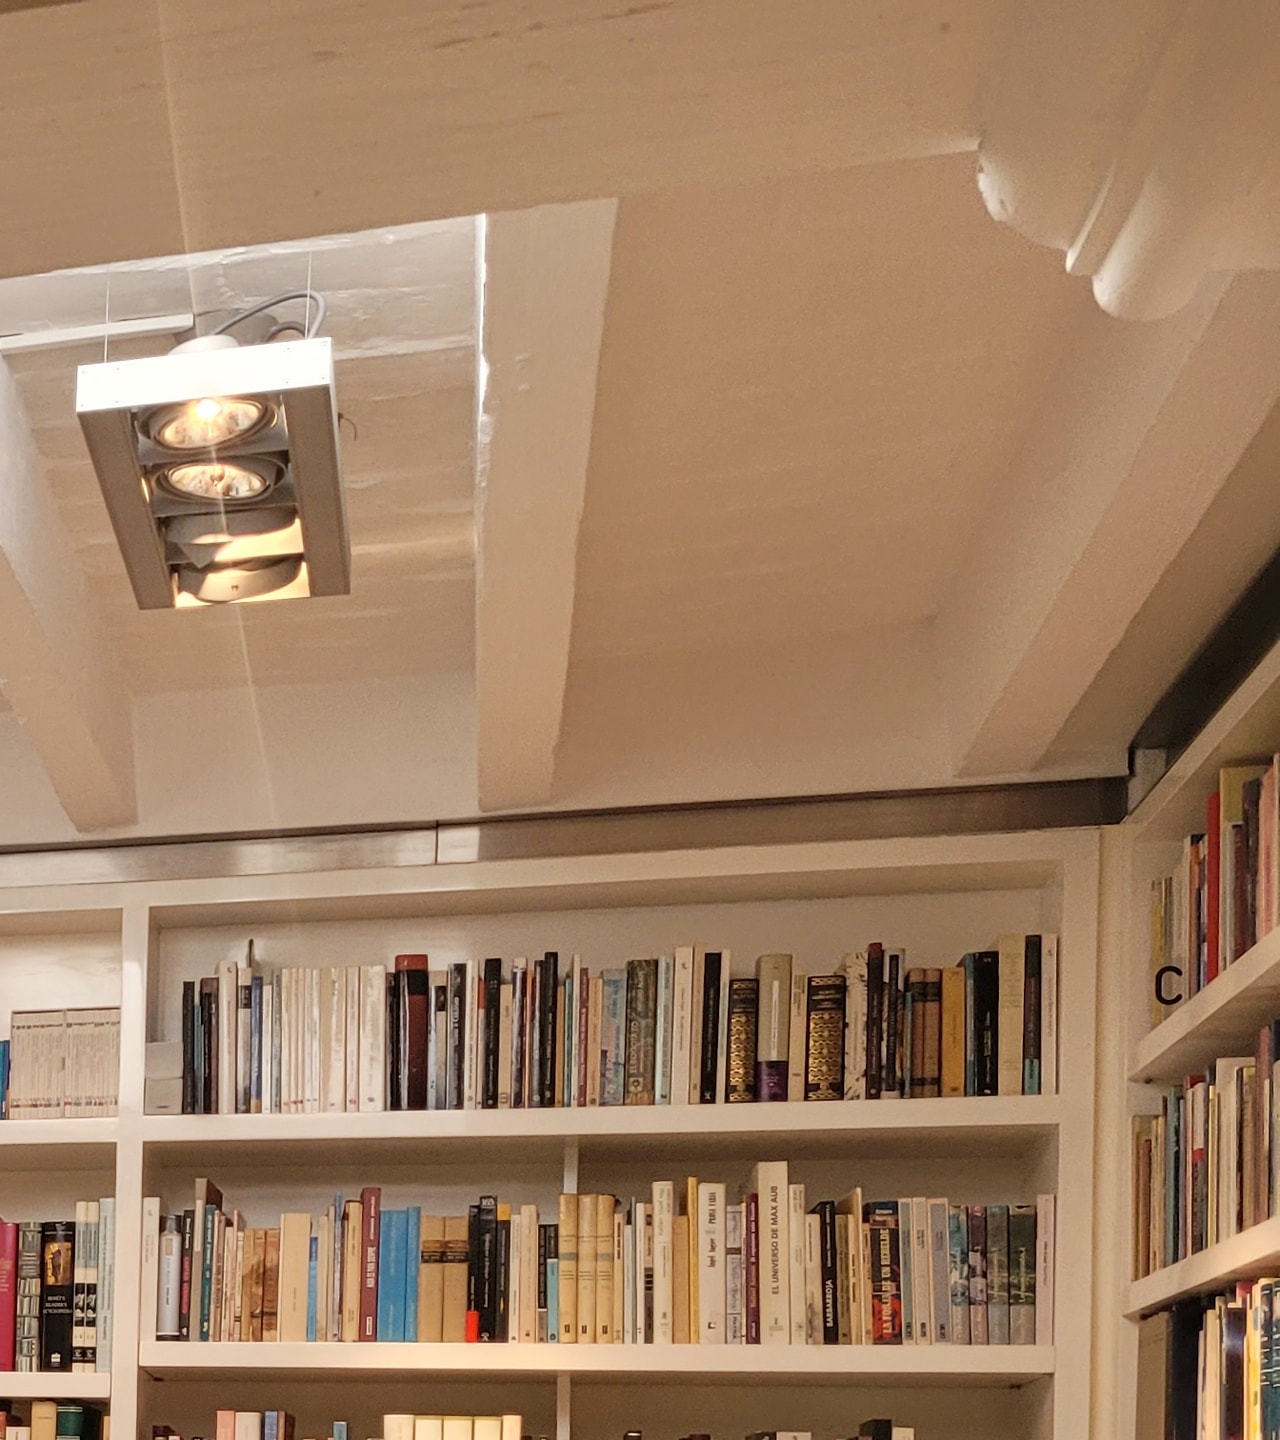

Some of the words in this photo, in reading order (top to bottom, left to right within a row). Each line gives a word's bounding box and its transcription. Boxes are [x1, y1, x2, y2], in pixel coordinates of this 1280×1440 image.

[1154, 965, 1183, 1006] C
[770, 1186, 778, 1203] AUB
[771, 1206, 779, 1225] MAX
[881, 1229, 890, 1264] REBELDE
[771, 1241, 779, 1282] UNIVERSO
[882, 1267, 891, 1277] UN
[882, 1281, 891, 1291] DE
[825, 1279, 834, 1327] BARBARROJA
[882, 1323, 892, 1333] LA
